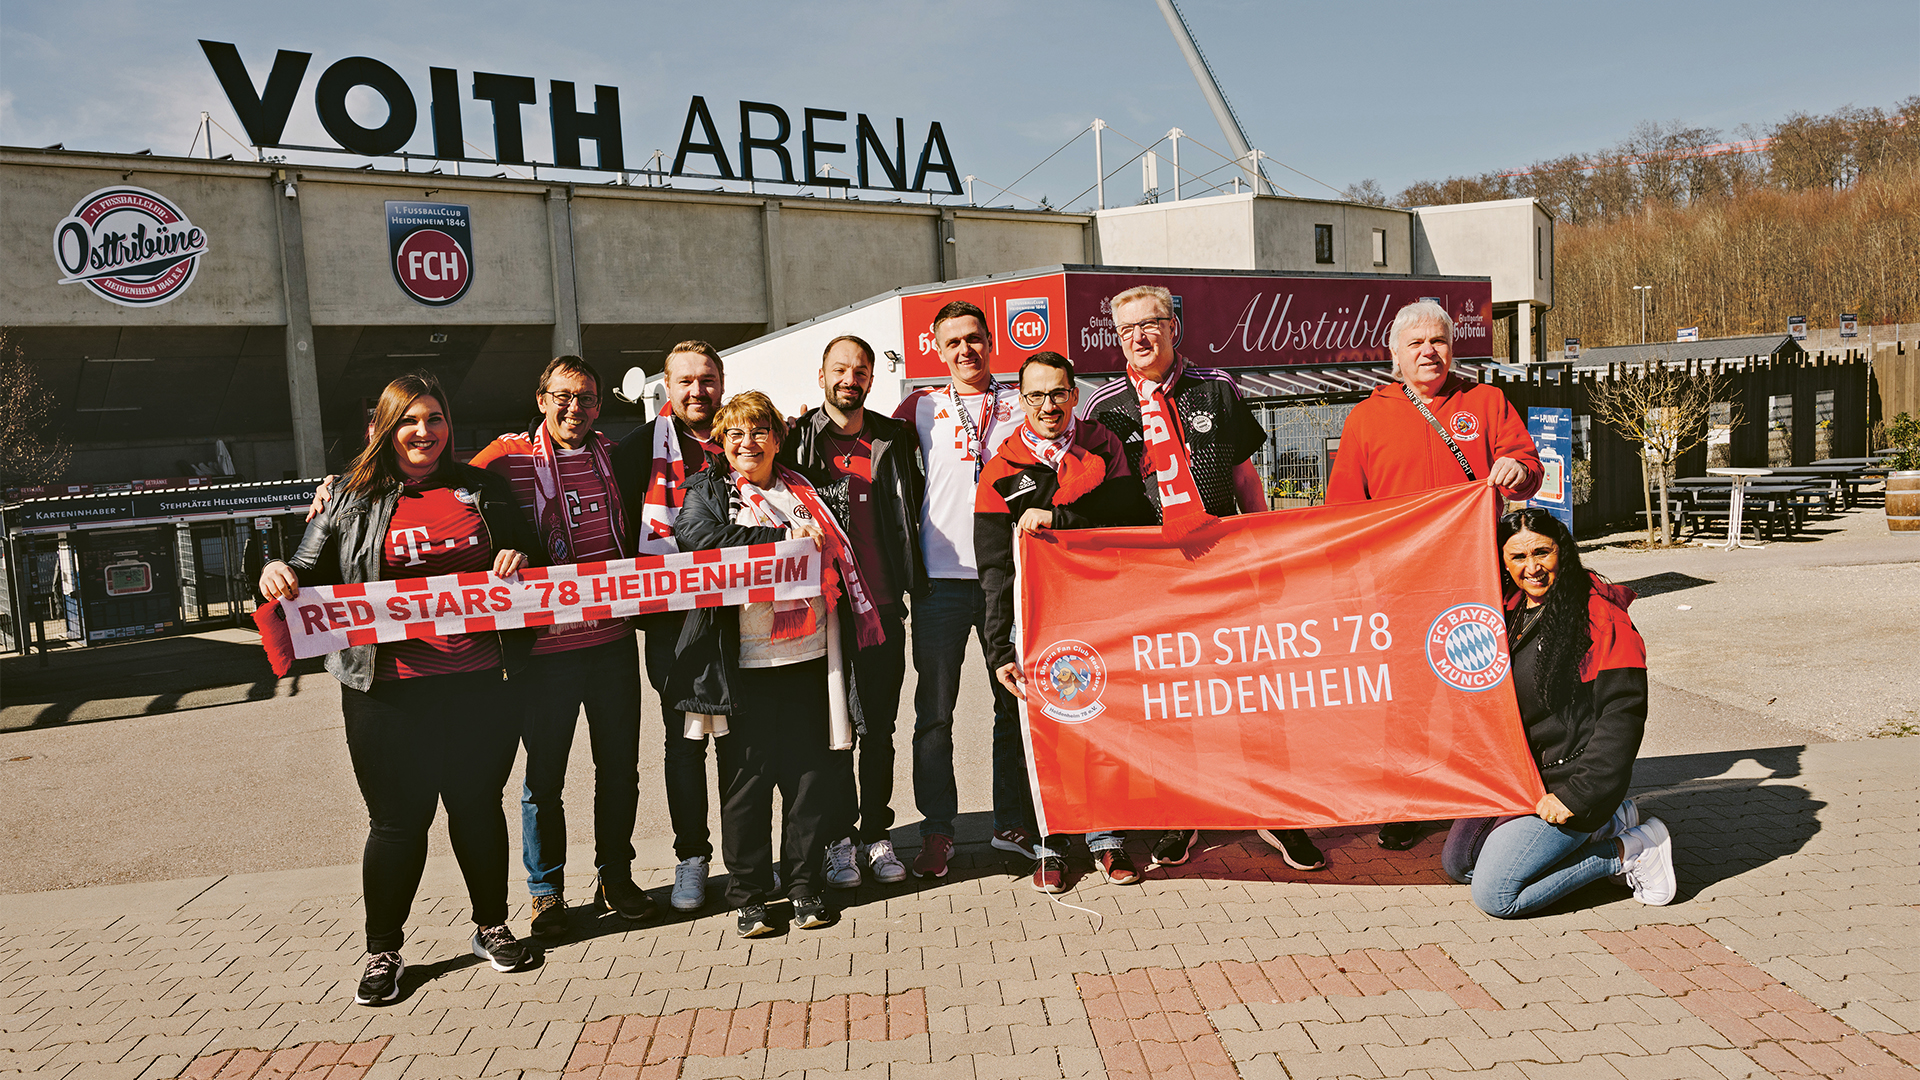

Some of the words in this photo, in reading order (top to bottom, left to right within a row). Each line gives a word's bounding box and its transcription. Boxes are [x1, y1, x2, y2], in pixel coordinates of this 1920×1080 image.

[197, 39, 625, 172] VOITH
[669, 95, 965, 195] ARENA
[100, 196, 166, 218] FUSSBALLCLUB
[446, 218, 466, 227] 1846
[58, 222, 205, 276] Osttribüne
[104, 279, 157, 295] HEIDENHEIM
[157, 277, 174, 291] 1846
[171, 267, 185, 281] E.V.
[408, 251, 459, 281] FCH
[1016, 321, 1042, 338] FCH
[1090, 315, 1116, 329] Stuttg
[1209, 291, 1392, 354] Albstüble
[1453, 321, 1486, 342] Hofbräu
[1081, 326, 1122, 352] Hofbr
[1416, 402, 1437, 423] RIGHT
[1438, 427, 1459, 452] THAT'S
[1454, 451, 1474, 475] RIGHT
[298, 598, 376, 635] RED
[389, 585, 513, 621] STARS
[592, 554, 809, 603] HEIDENHEIM
[1432, 624, 1449, 644] FC
[1447, 608, 1506, 637] BAYERN
[1132, 631, 1202, 671] RED
[1213, 619, 1322, 666] STARS
[1333, 612, 1393, 653] '78
[1040, 651, 1056, 675] Bayern
[1056, 645, 1071, 653] Fan
[1072, 645, 1089, 657] Club
[1436, 651, 1508, 686] MÜNCHEN
[1142, 663, 1393, 720] HEIDENHEIM
[1048, 707, 1080, 718] Heidenheim
